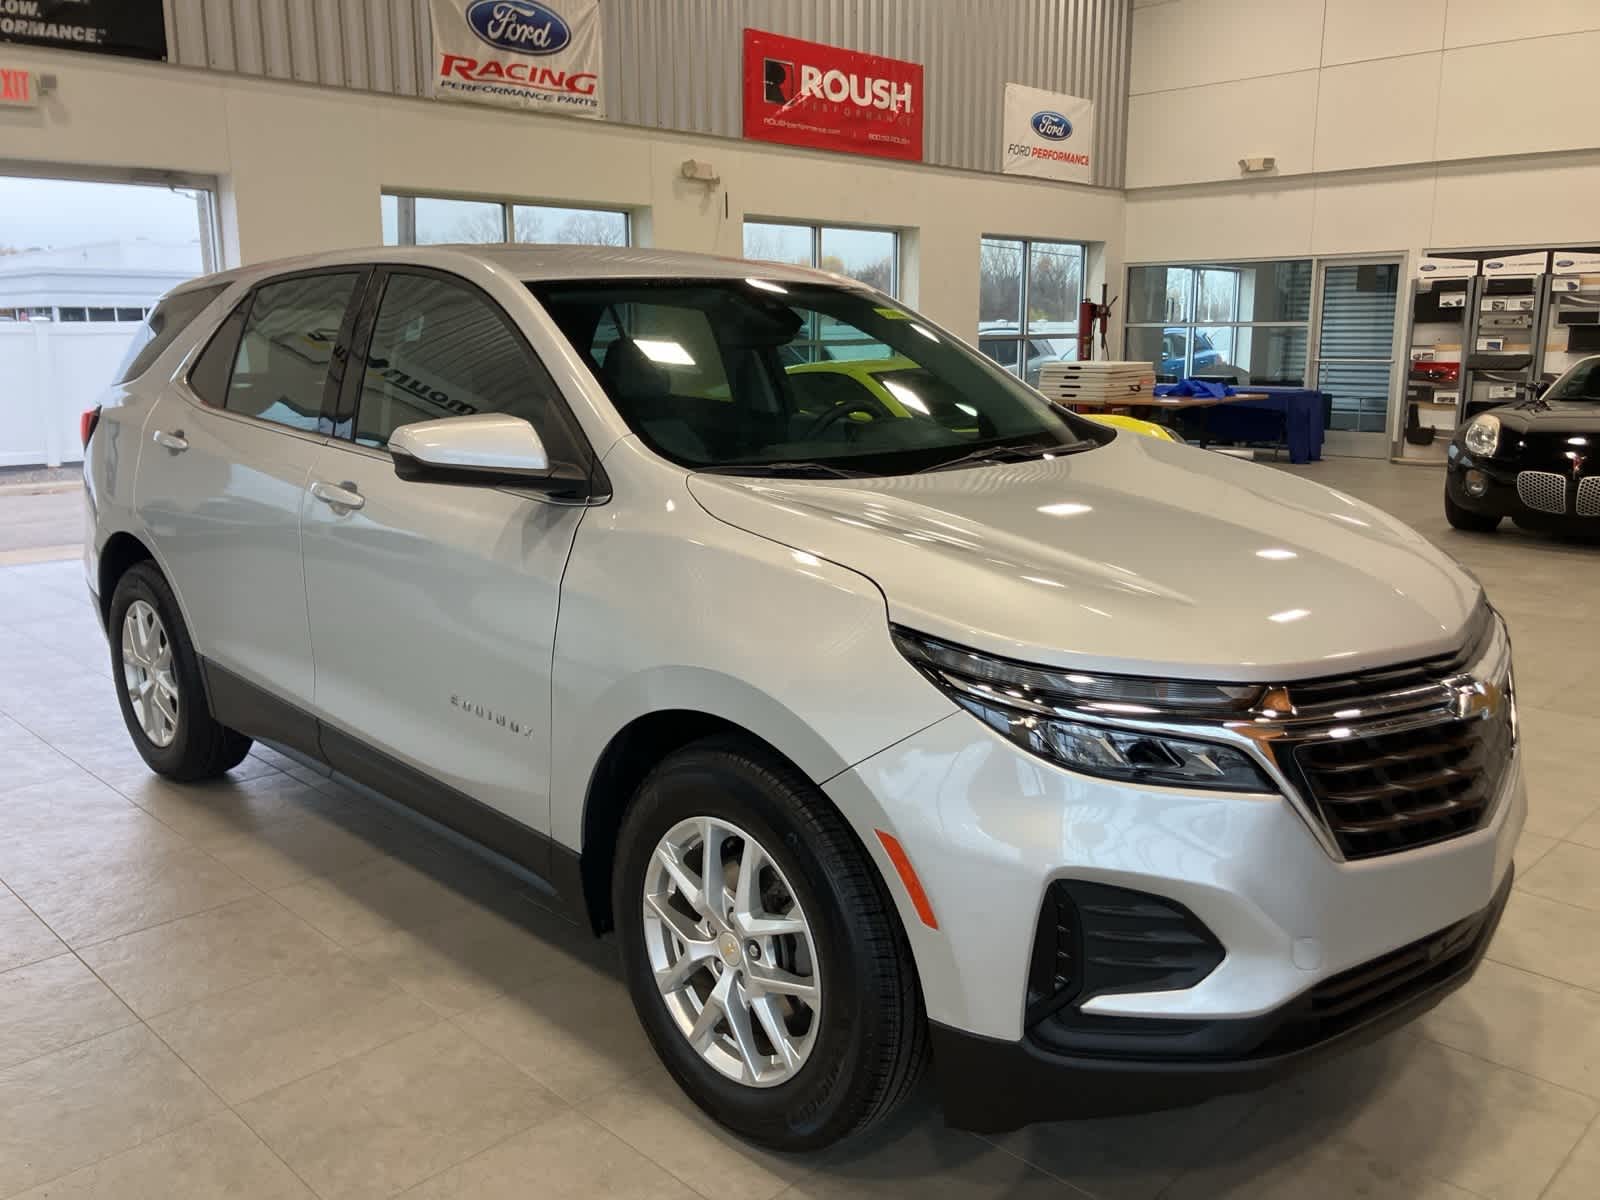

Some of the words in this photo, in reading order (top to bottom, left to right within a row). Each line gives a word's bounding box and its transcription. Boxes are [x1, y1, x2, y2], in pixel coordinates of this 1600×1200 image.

[0, 17, 103, 44] ORMANCE.
[487, 3, 552, 48] Ford
[440, 53, 598, 95] RACING
[440, 80, 553, 101] PERFORMANCE
[557, 96, 598, 107] PARTS
[801, 64, 912, 113] ROUSH
[1039, 114, 1065, 136] Ford
[1007, 143, 1031, 157] FORD
[1031, 147, 1089, 166] PERFORMANCE
